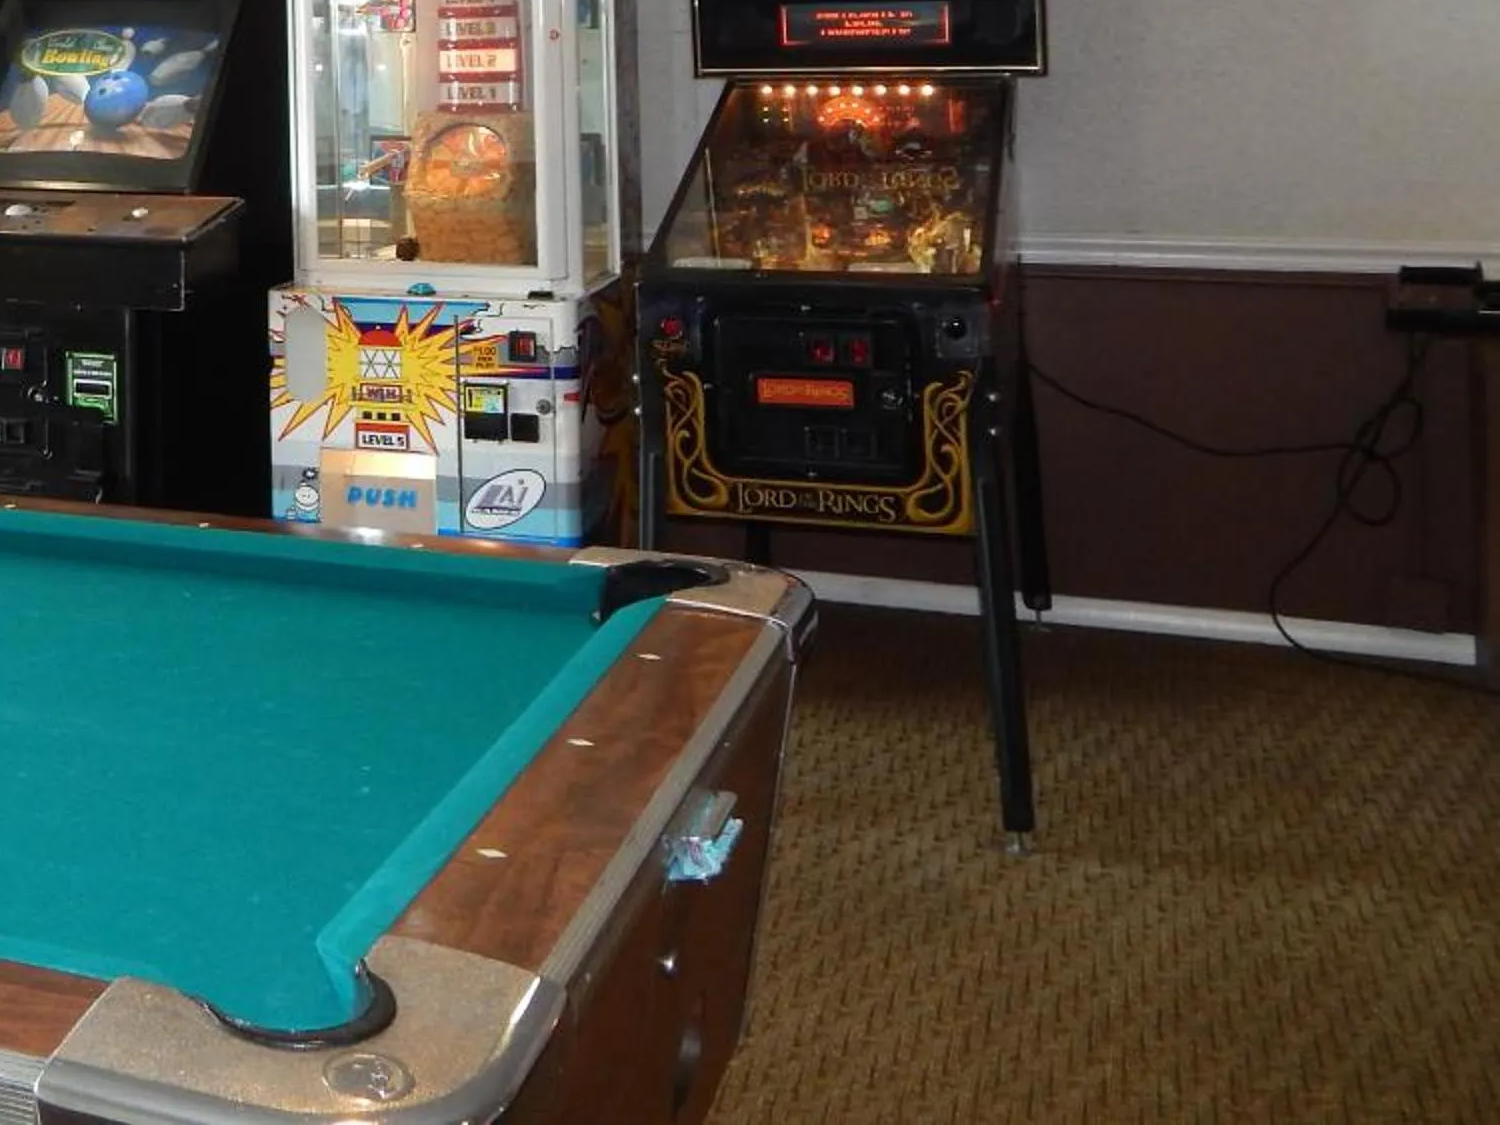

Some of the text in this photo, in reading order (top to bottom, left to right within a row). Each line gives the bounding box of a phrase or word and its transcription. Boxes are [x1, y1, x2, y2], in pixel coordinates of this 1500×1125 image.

[445, 21, 483, 36] LVEL
[446, 53, 484, 68] LVEL
[447, 86, 486, 100] LVEL
[361, 434, 395, 446] LEVEL
[346, 484, 418, 509] PUSH
[737, 482, 797, 514] LORD
[818, 489, 897, 524] RINGS
